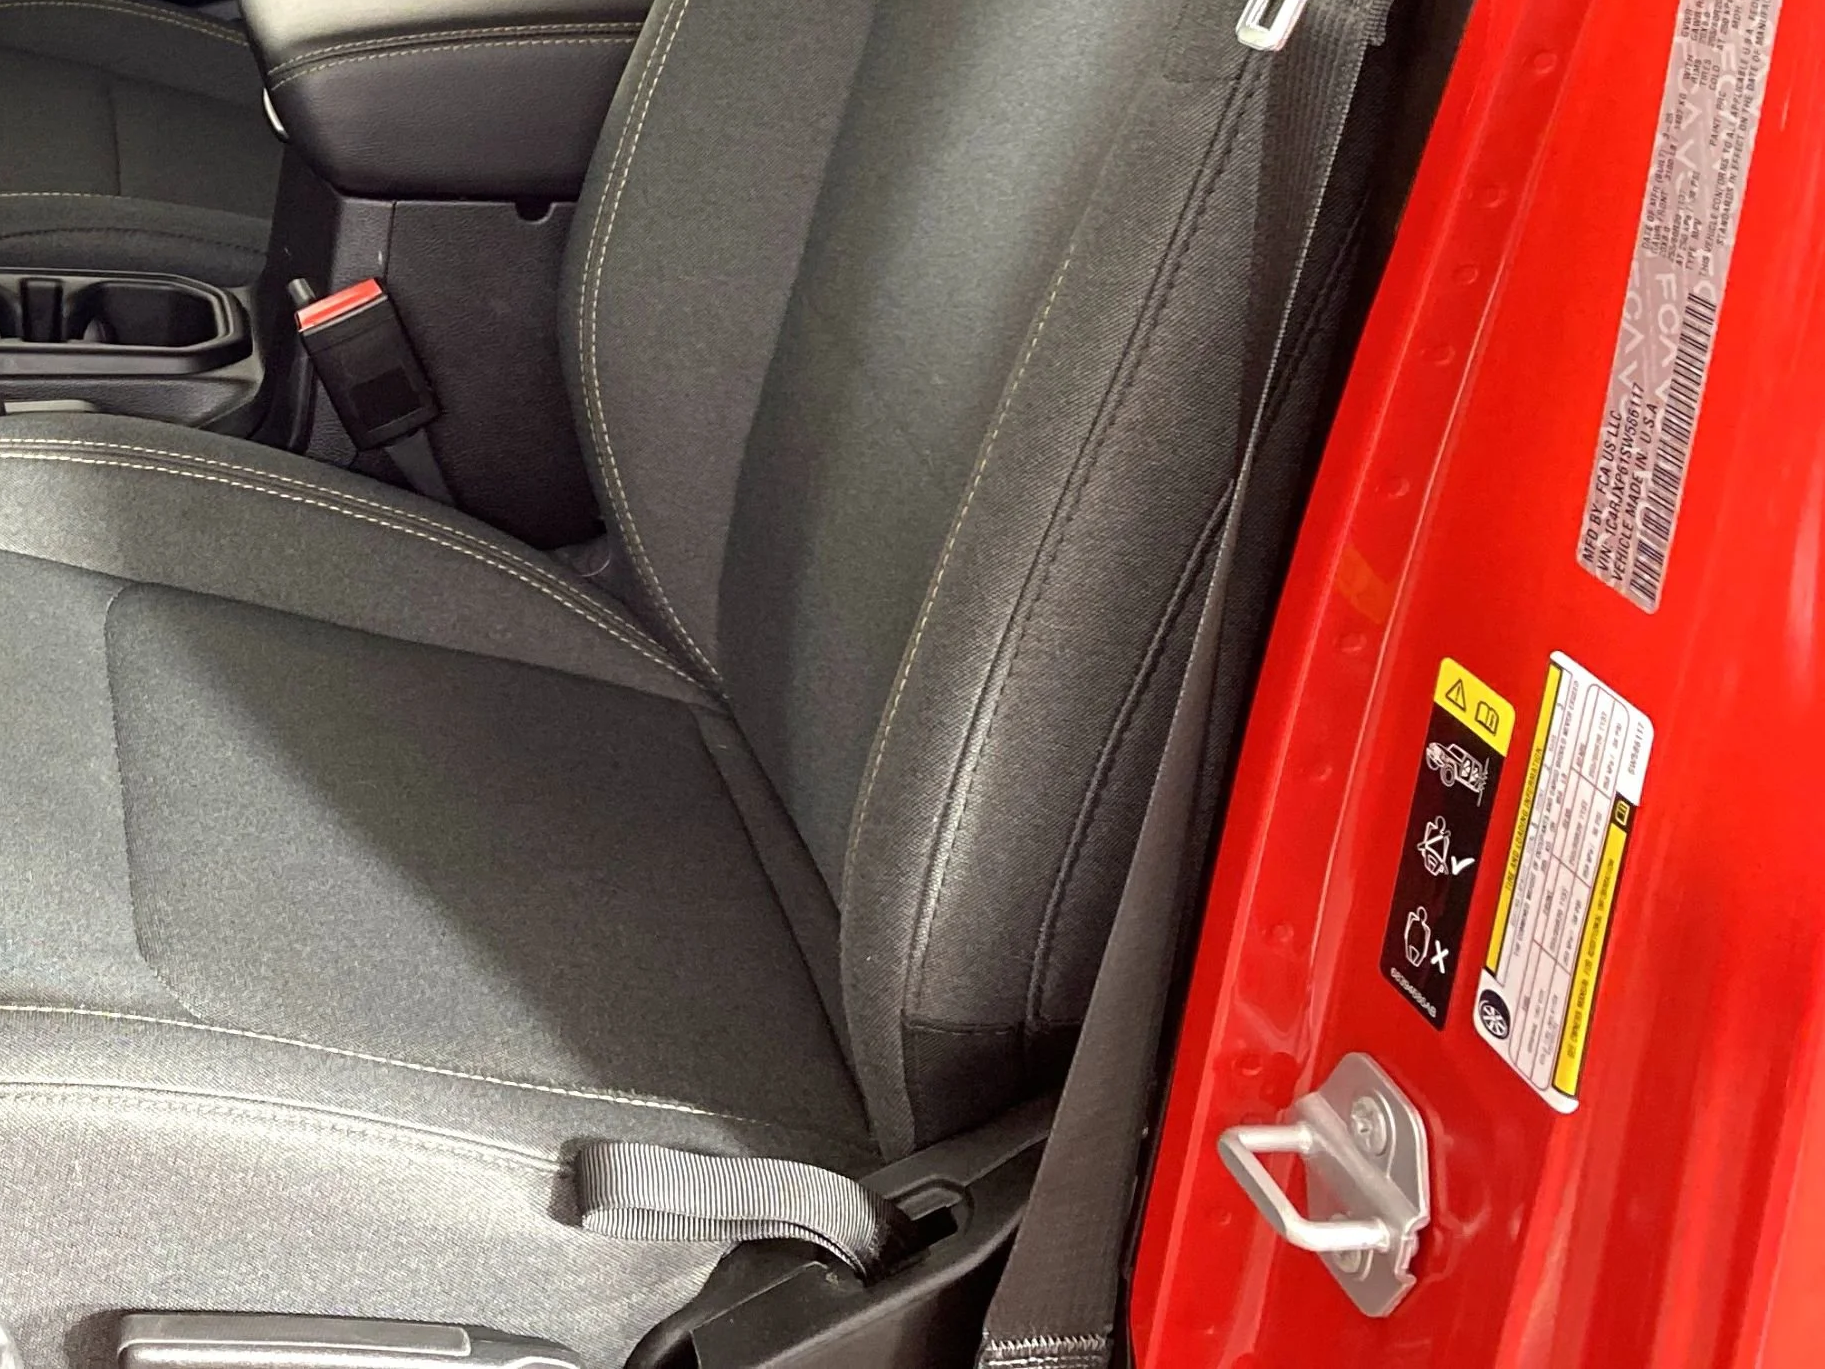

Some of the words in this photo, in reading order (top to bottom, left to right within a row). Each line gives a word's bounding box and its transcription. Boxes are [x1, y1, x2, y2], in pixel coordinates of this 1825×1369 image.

[1682, 53, 1693, 80] WITH
[1708, 63, 1720, 91] COLD
[1703, 212, 1717, 253] VEHICLE
[1711, 156, 1728, 211] CONFORMS
[1729, 58, 1748, 118] APPLICABLE
[1715, 185, 1734, 246] STANDARDS
[1730, 133, 1745, 170] EFFECT
[1745, 64, 1758, 91] DATE
[1607, 409, 1621, 437] LLC
[1603, 439, 1615, 461] US
[1596, 464, 1610, 494] FCA
[1612, 519, 1632, 582] VEHICLE
[1625, 473, 1642, 517] MADE
[1583, 527, 1597, 563] MFD
